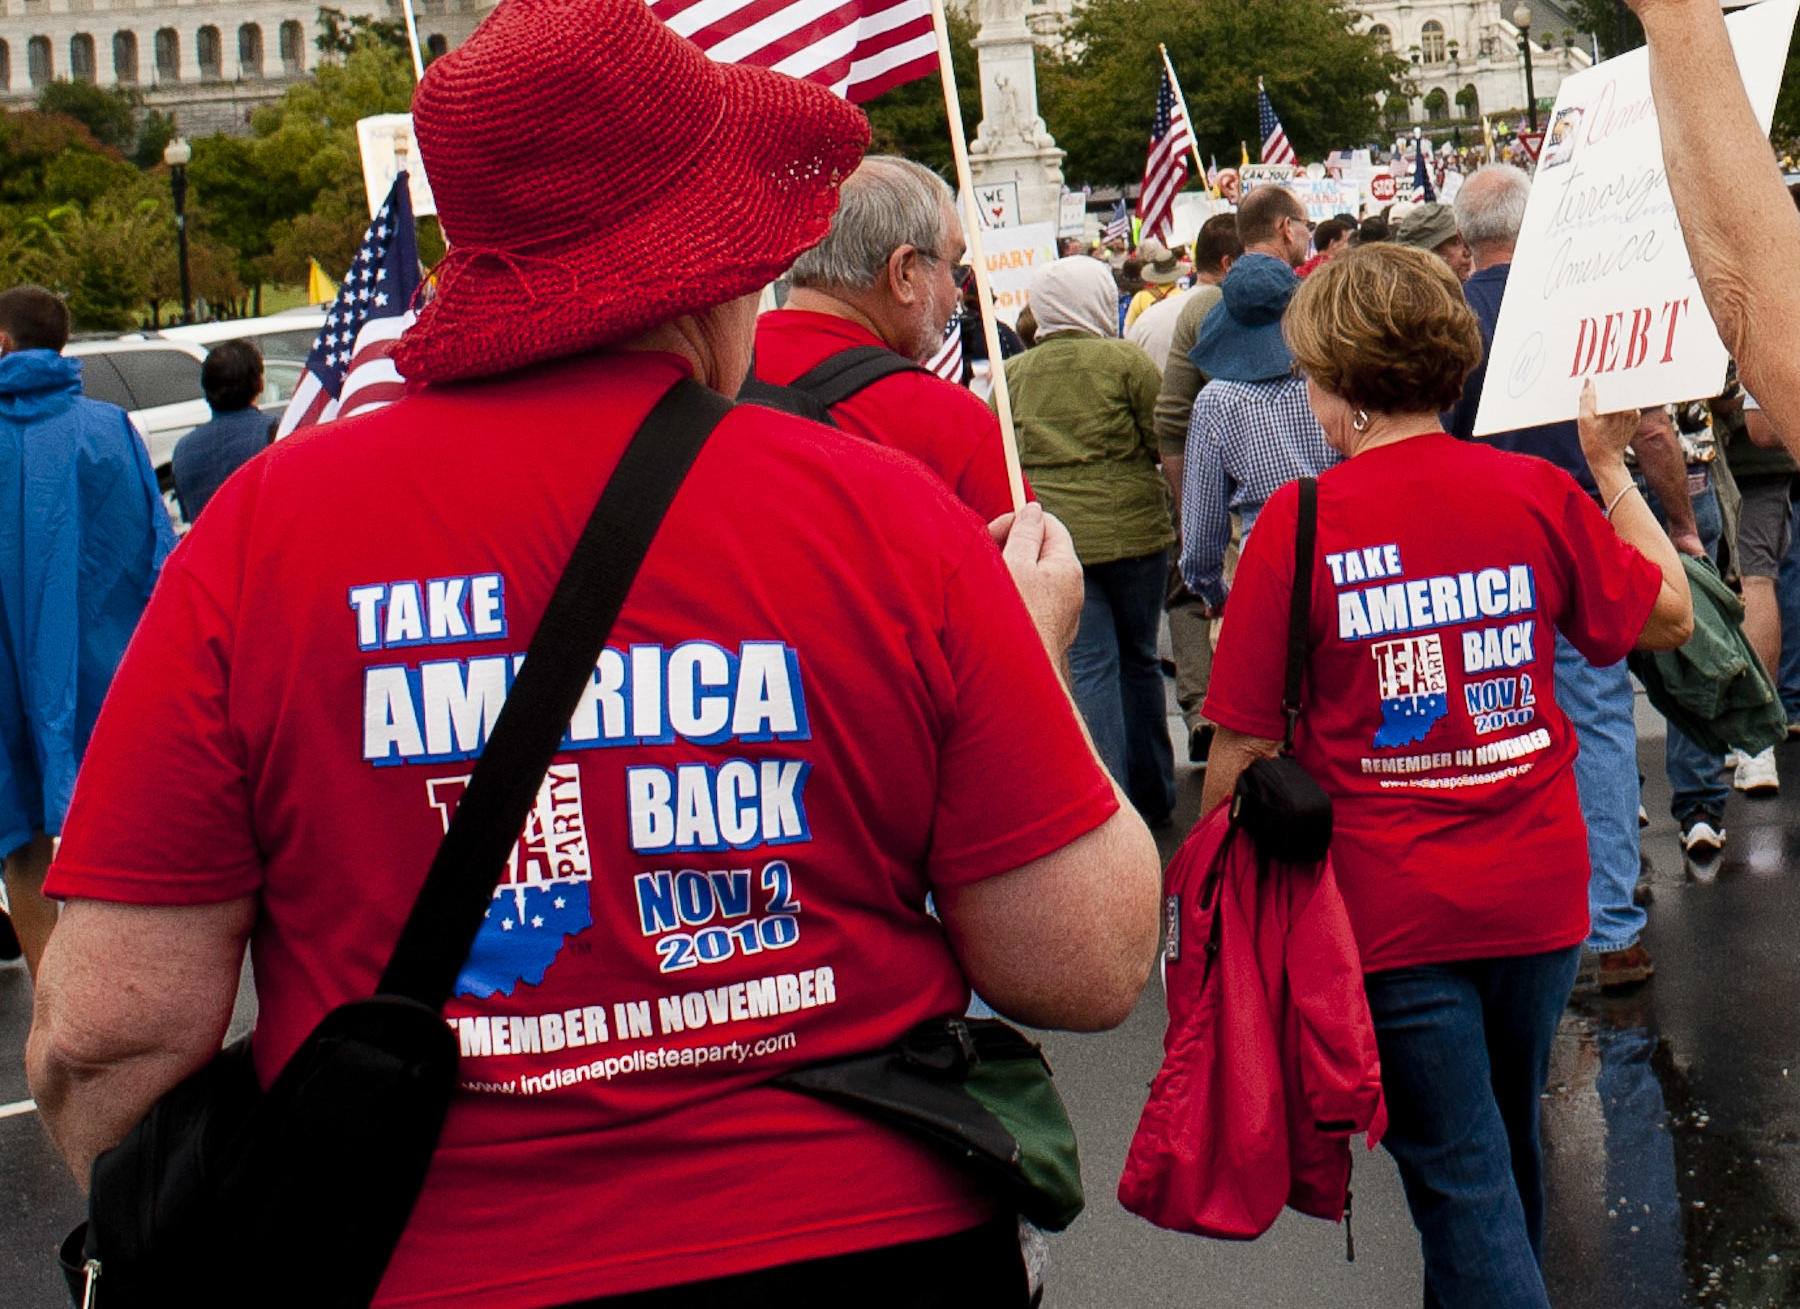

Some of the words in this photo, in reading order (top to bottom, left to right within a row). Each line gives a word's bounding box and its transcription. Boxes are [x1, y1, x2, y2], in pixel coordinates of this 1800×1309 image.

[983, 189, 1005, 203] WE
[1242, 169, 1265, 181] CAN
[1268, 169, 1290, 181] YOU
[1568, 296, 1690, 379] DEBT
[1325, 542, 1403, 587] TAKE
[349, 572, 508, 651] TAKE
[1337, 563, 1537, 642] AMERICA
[1371, 637, 1431, 701] TEA
[1425, 638, 1444, 692] PARTY
[1461, 620, 1537, 675] BACK
[362, 640, 813, 767] AMRICA
[1464, 677, 1517, 717] NOV
[1519, 673, 1536, 707] 2
[1474, 706, 1535, 736] 2010
[1361, 751, 1453, 774] REMEMBER
[1455, 749, 1474, 768] IN
[1476, 728, 1551, 765] NOVEMBER
[547, 767, 589, 878] PARTY
[625, 757, 814, 856] BACK
[634, 869, 751, 938] NOV
[761, 860, 801, 916] 2
[656, 914, 801, 974] 2010
[446, 1005, 609, 1058] MEMBER
[614, 997, 653, 1039] IN
[658, 965, 838, 1035] NOVEMBER
